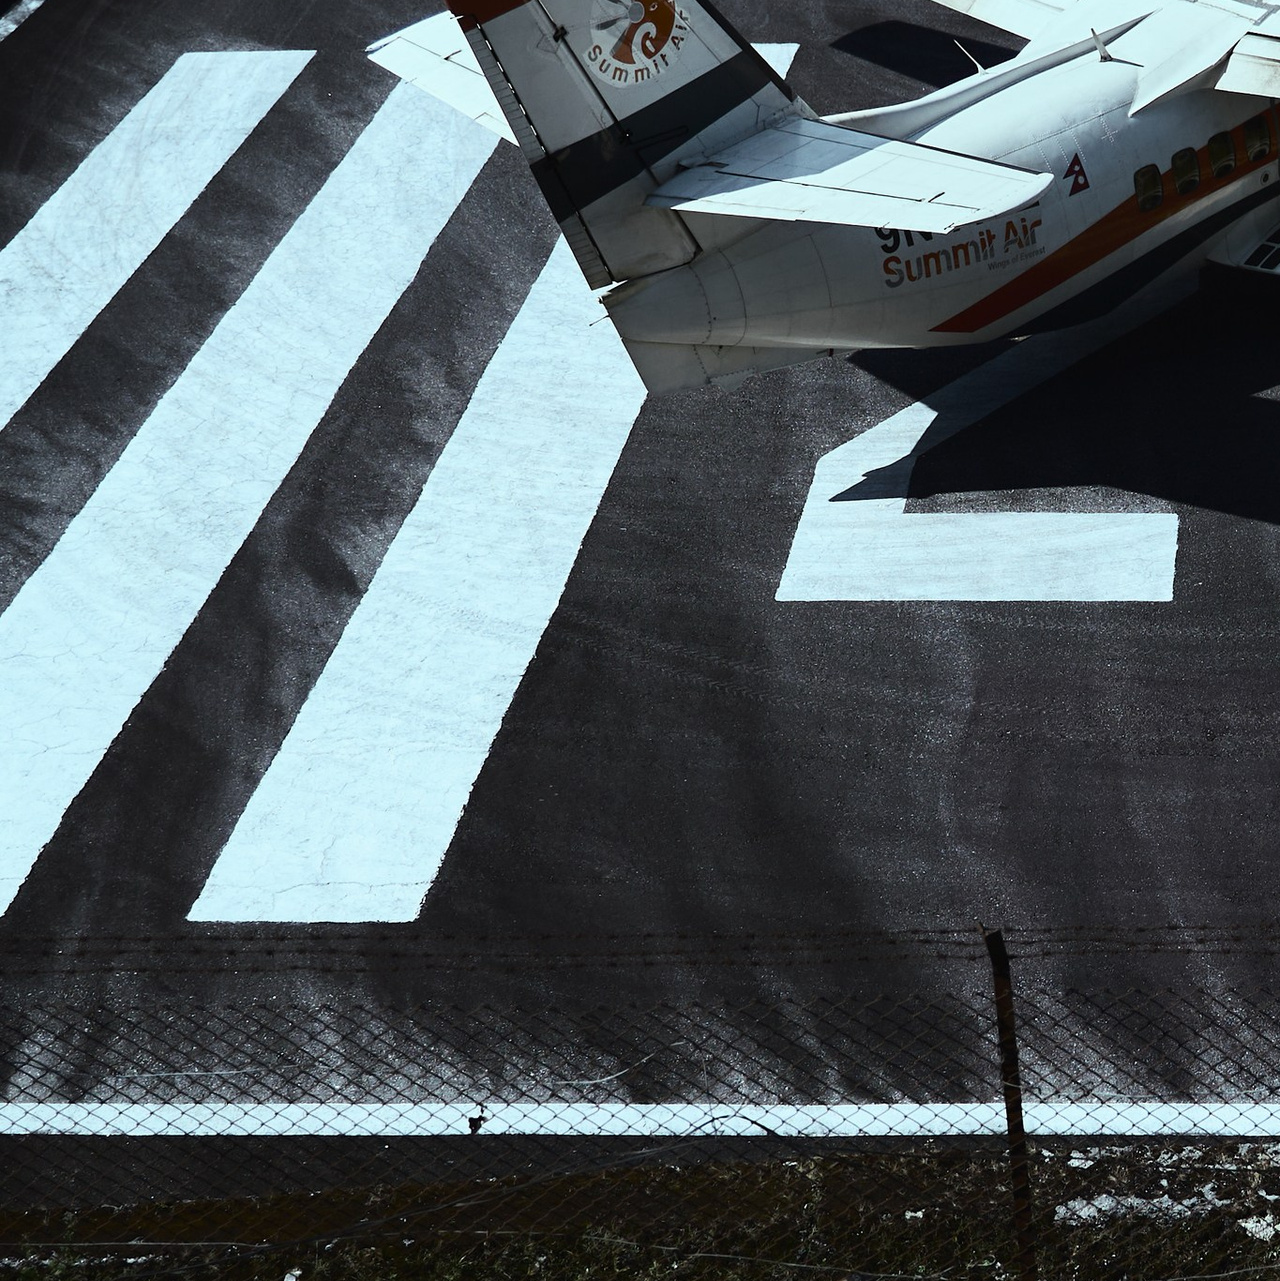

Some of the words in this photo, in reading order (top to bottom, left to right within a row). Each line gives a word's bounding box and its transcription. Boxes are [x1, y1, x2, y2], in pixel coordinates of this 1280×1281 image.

[883, 229, 996, 288] Summit
[1004, 218, 1043, 253] Air
[987, 258, 1010, 272] Wings
[1020, 245, 1047, 261] Everest
